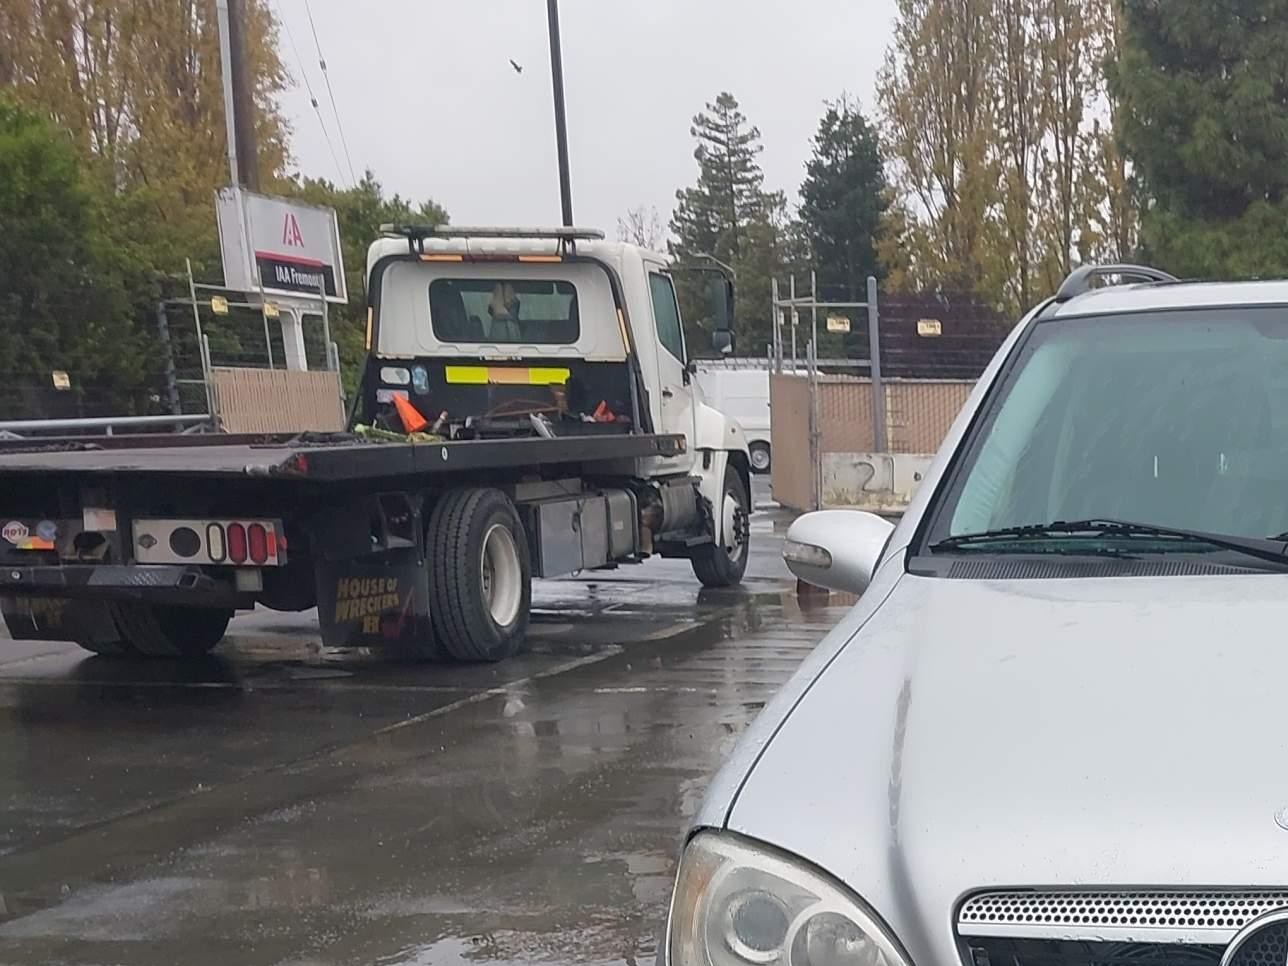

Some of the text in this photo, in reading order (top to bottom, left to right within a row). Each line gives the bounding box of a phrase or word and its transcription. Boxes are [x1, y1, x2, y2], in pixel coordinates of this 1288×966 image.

[275, 265, 291, 284] IAA
[336, 577, 385, 598] HOUSE
[336, 593, 400, 624] WRECKERS
